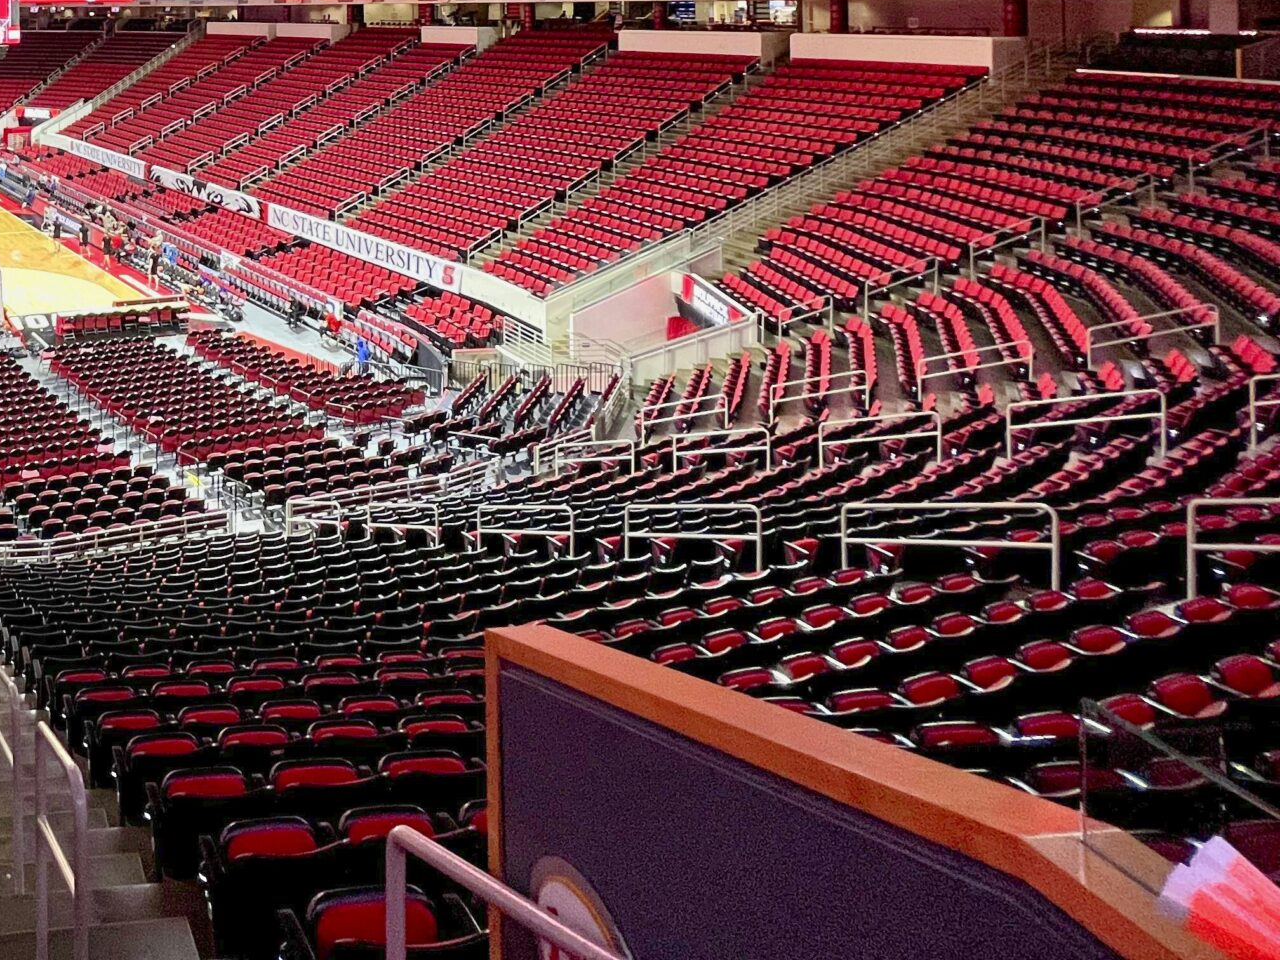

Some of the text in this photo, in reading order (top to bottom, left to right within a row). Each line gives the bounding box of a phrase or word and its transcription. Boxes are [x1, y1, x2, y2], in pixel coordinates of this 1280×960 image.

[101, 151, 141, 175] UNIVERSITY
[273, 208, 290, 228] NC
[293, 214, 331, 242] STATE
[335, 228, 437, 279] UNIVERSITY
